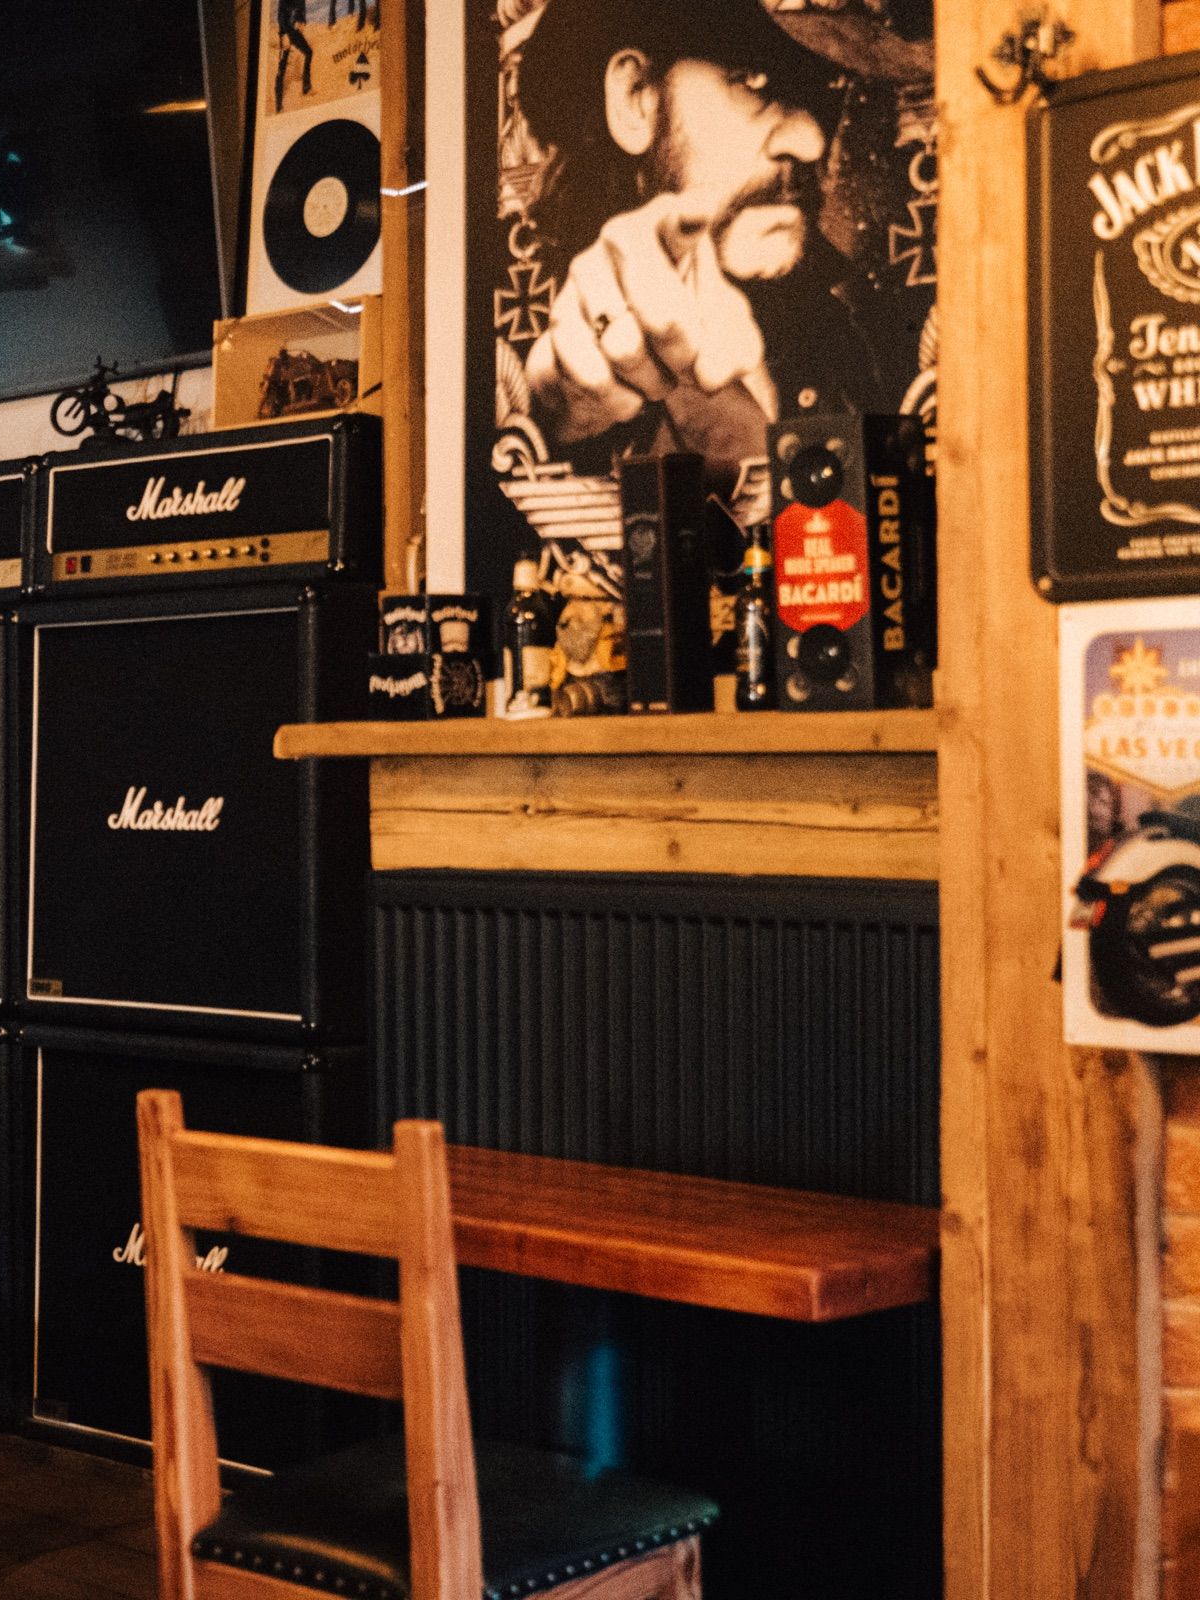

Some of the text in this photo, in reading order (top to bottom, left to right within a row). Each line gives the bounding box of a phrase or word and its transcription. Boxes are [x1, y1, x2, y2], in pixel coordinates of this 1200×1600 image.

[1088, 140, 1193, 240] JACK
[1132, 376, 1200, 411] WH
[127, 476, 245, 521] Marshall
[871, 475, 905, 651] BACARDÍ
[779, 574, 863, 606] BACARDÍ
[1099, 736, 1148, 759] LAS
[108, 786, 223, 831] Marshall
